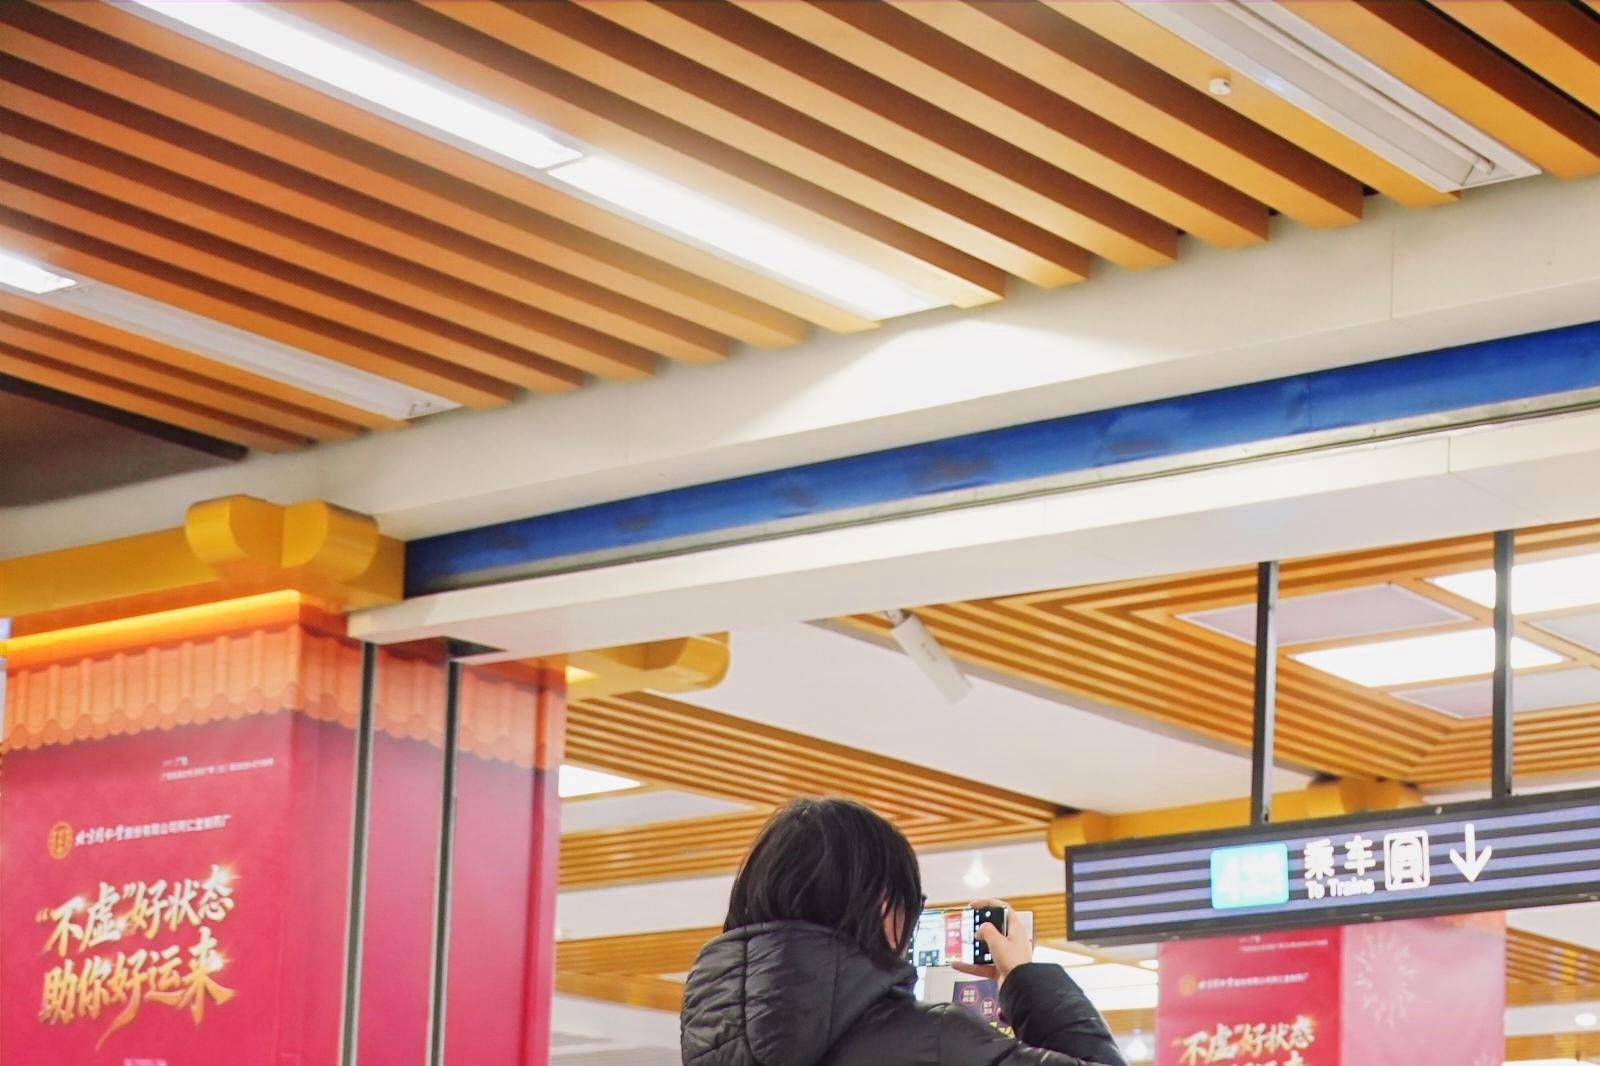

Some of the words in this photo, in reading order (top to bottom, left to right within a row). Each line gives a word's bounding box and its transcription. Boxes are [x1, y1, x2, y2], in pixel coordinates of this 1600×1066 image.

[1304, 835, 1376, 880] 乘车
[1305, 880, 1325, 899] To
[1327, 876, 1375, 896] Trains
[38, 926, 238, 1050] 助你好运来
